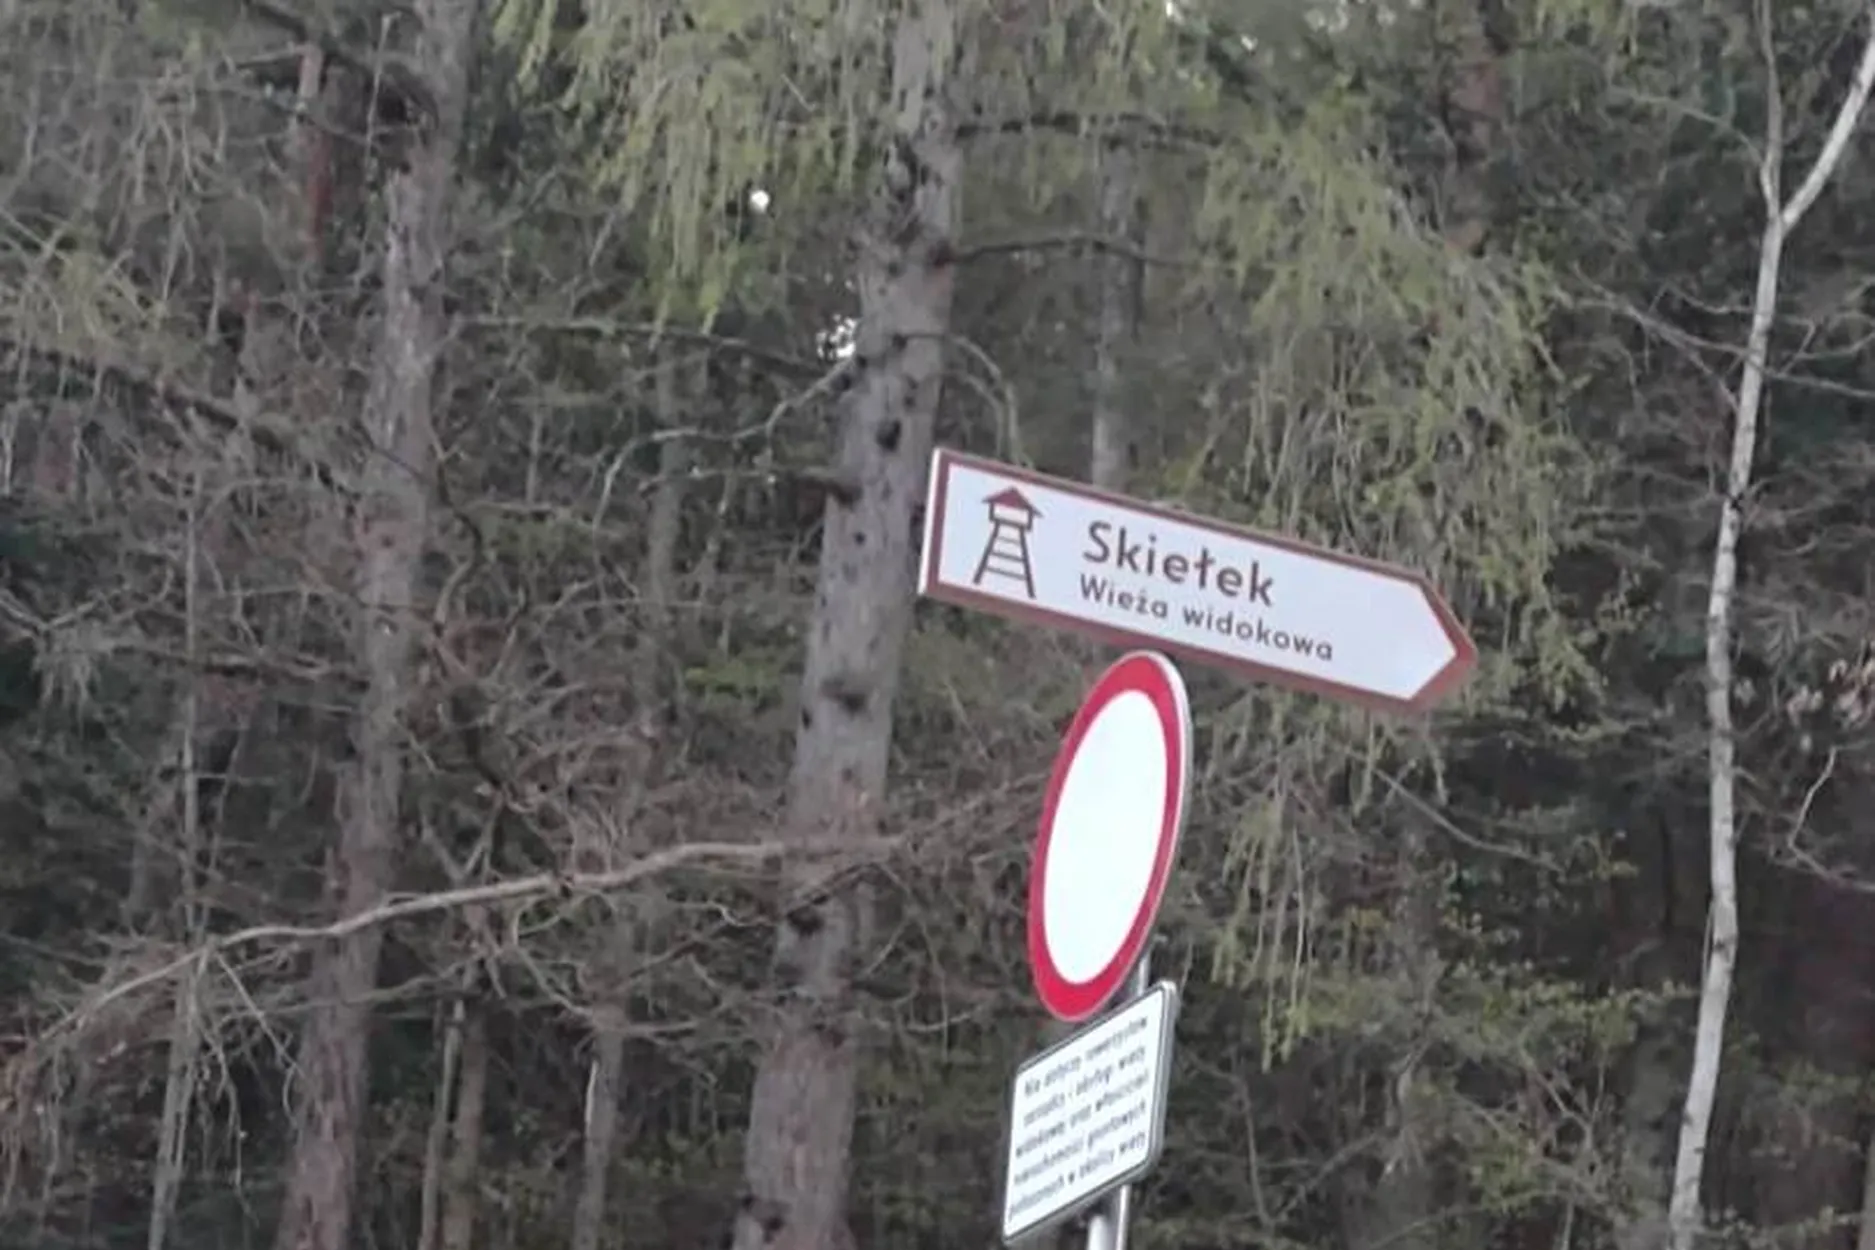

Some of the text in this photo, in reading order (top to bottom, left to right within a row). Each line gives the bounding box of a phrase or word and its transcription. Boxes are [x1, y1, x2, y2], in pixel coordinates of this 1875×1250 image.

[1082, 520, 1275, 607] Skiełek
[1080, 573, 1333, 661] Wieża widokowa
